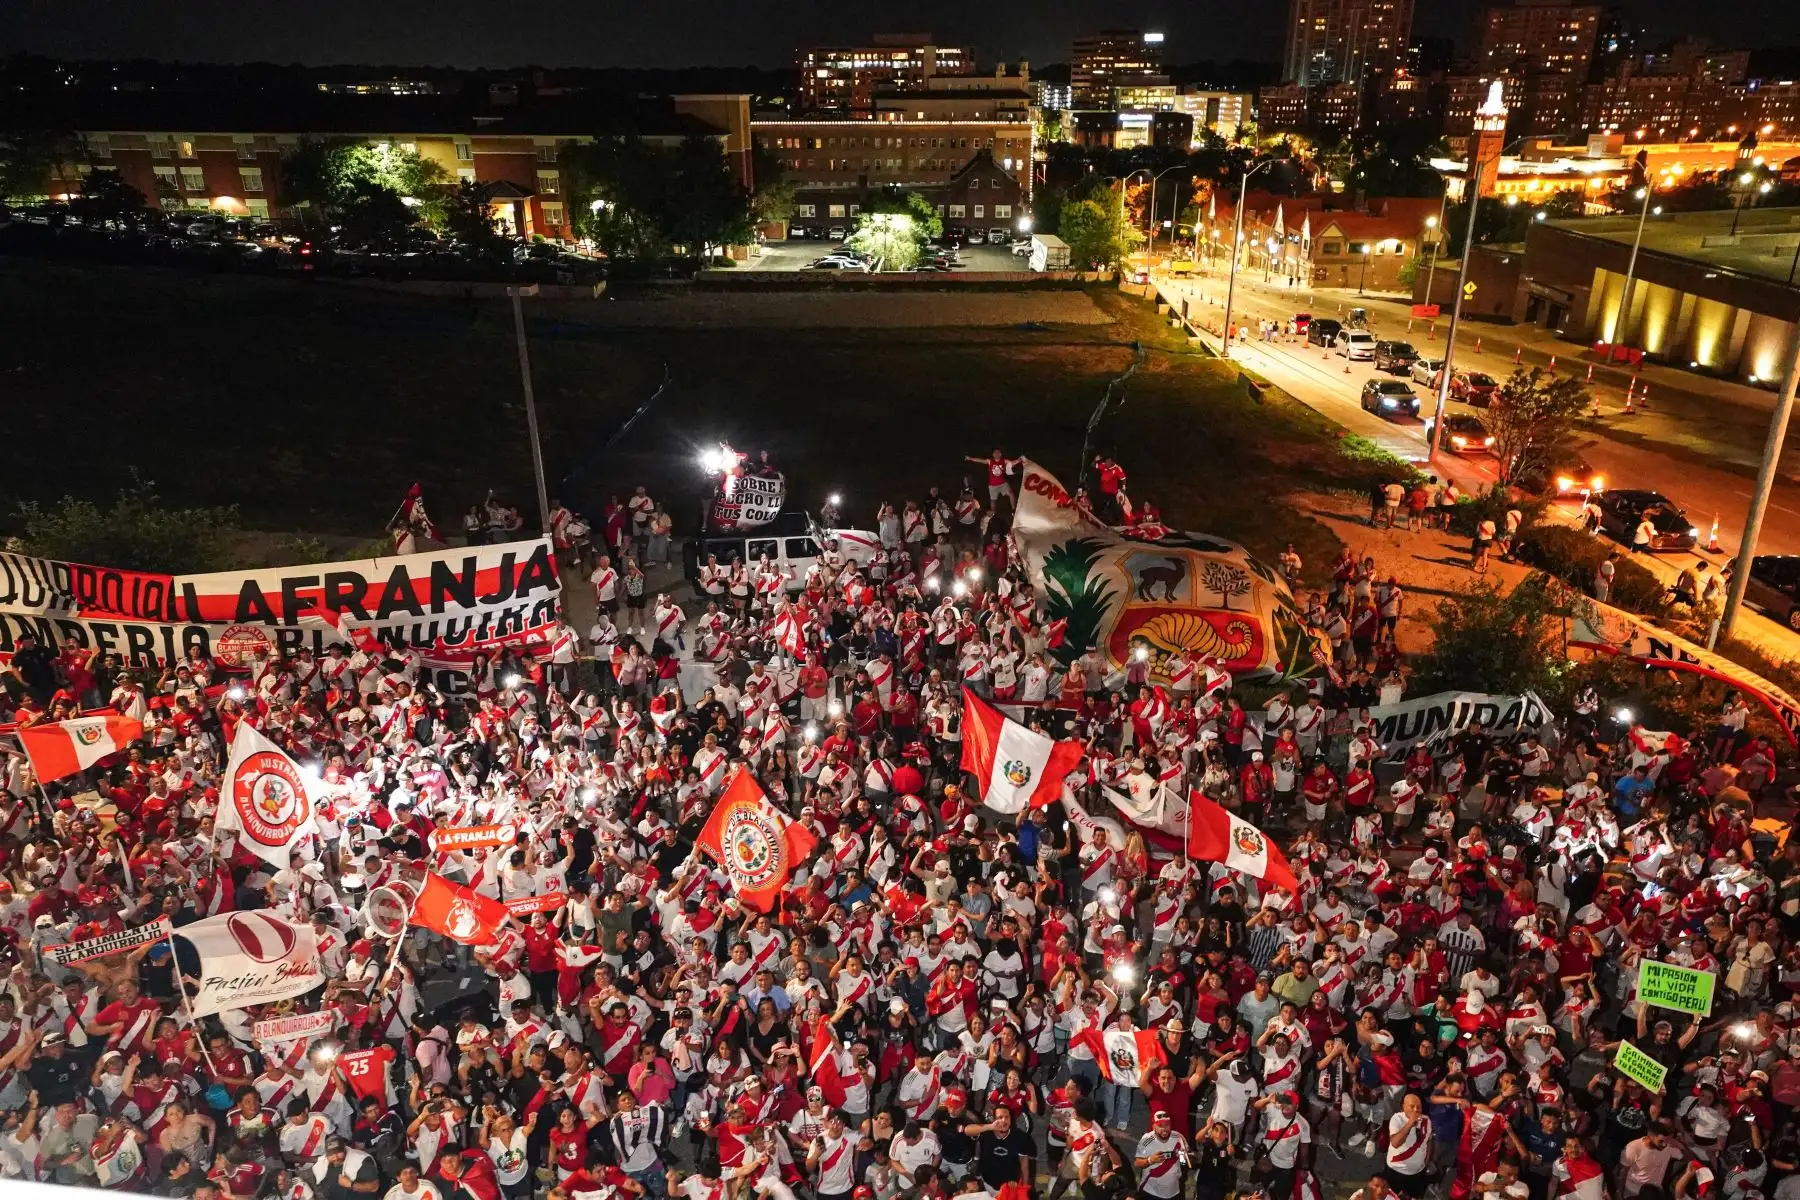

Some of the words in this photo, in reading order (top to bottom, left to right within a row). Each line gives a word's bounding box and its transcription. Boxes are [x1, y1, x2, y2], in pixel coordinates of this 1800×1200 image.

[733, 478, 776, 494] SOBRE
[714, 505, 743, 521] TUS
[281, 543, 561, 627] FRANJA
[260, 758, 305, 793] AUSTRALIA
[438, 832, 453, 845] LA
[454, 829, 497, 844] FRANJA
[56, 929, 163, 965] BLANQUIRROJO
[350, 1058, 370, 1077] 25
